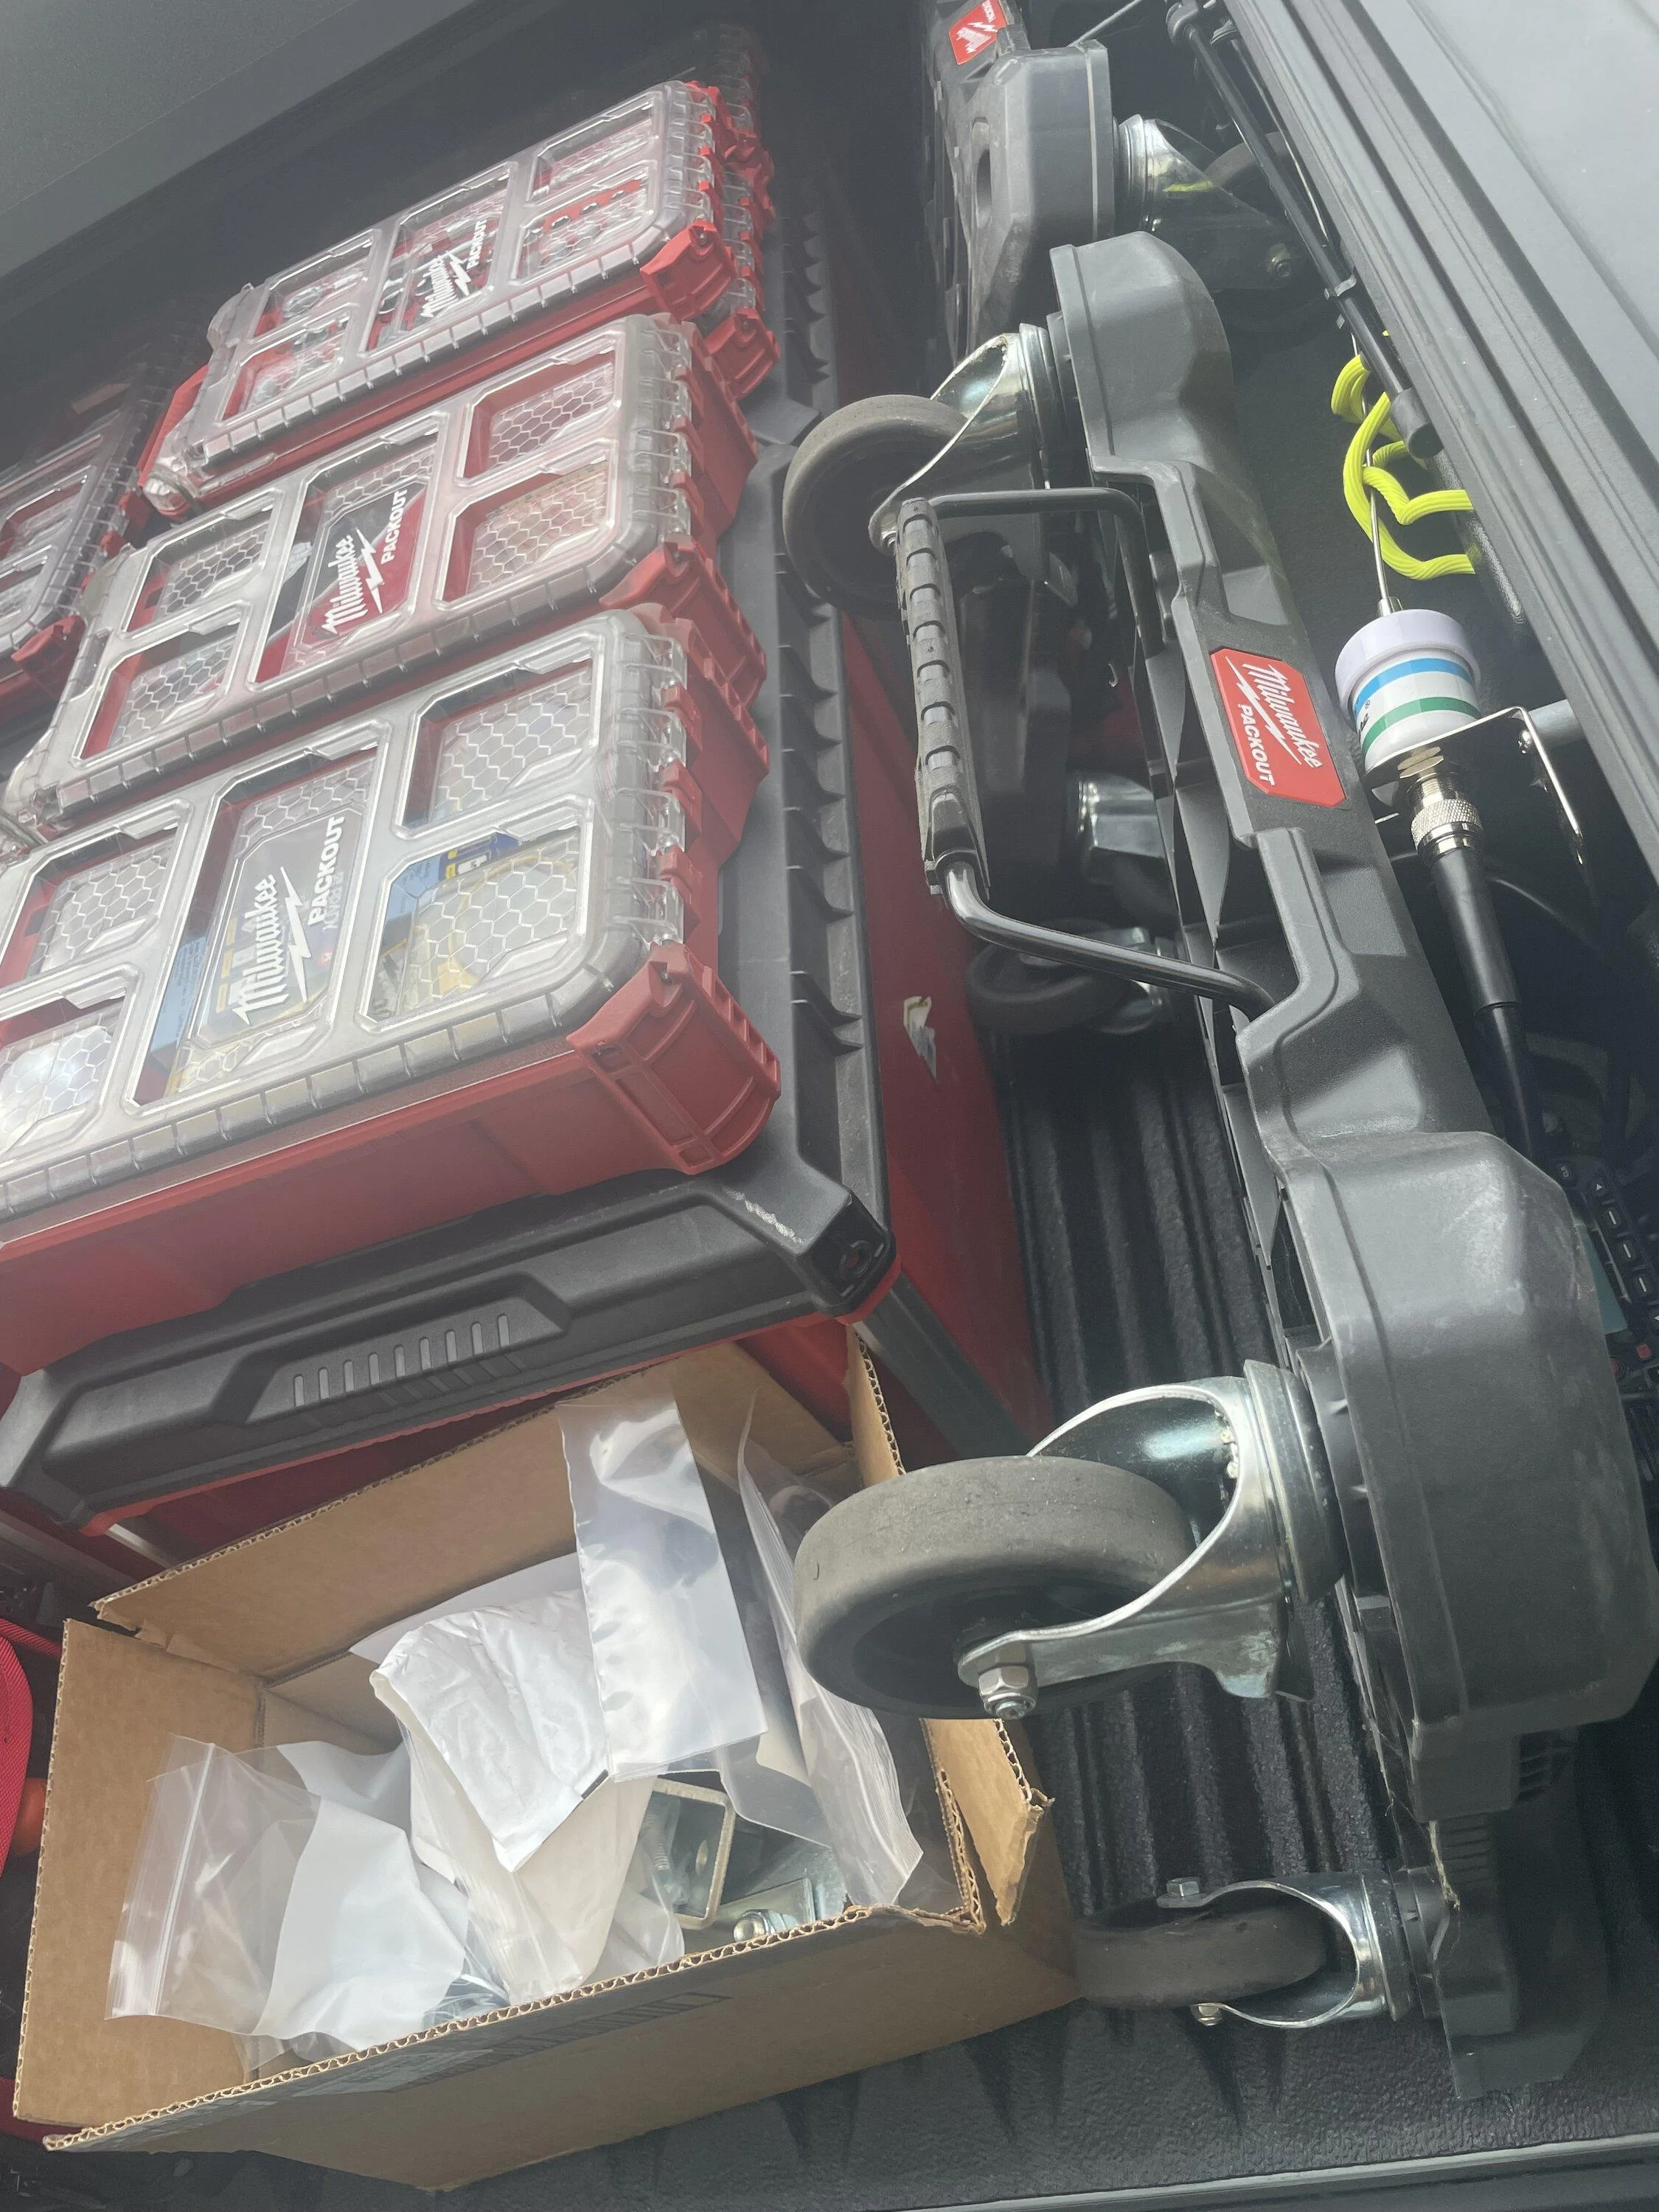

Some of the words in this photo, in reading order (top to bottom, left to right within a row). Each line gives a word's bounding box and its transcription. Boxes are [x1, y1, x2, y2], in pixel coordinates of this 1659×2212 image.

[420, 255, 459, 318] Milwaukee
[466, 219, 487, 270] PACKOUT
[380, 490, 407, 565] PACKOUT
[321, 535, 369, 634] Milwaukee
[1238, 703, 1275, 786] PACKOUT
[1242, 663, 1323, 768] Milwaukee
[307, 815, 345, 925] PACKOUT
[232, 874, 289, 1026] Milwaukee
